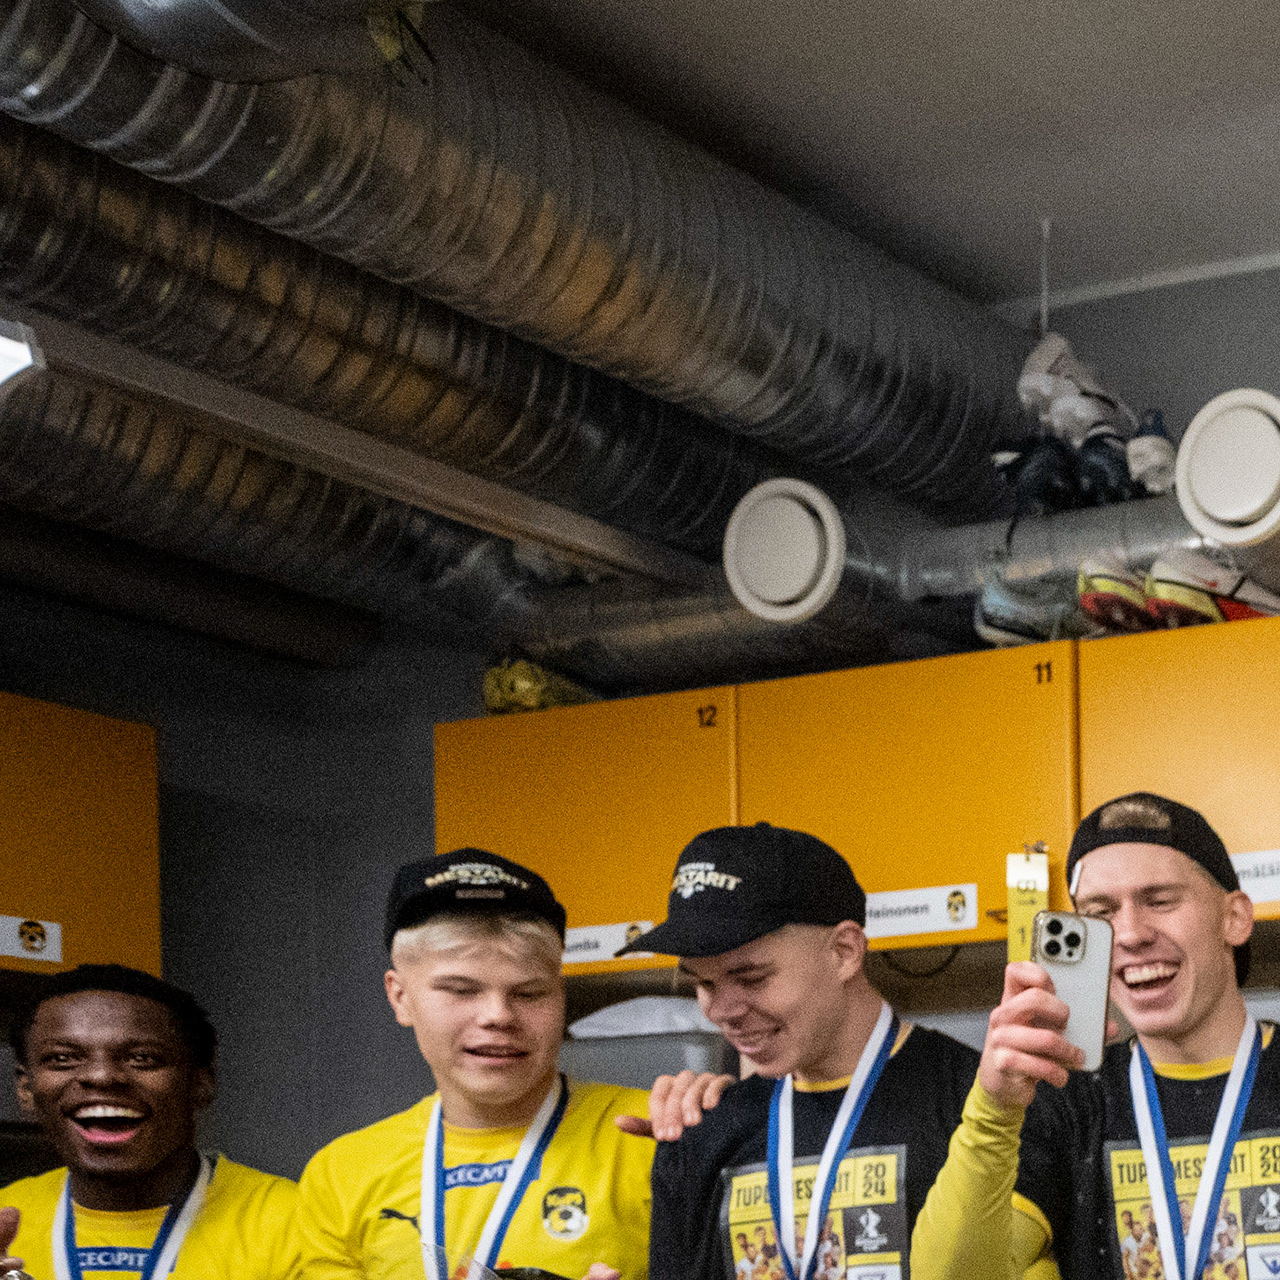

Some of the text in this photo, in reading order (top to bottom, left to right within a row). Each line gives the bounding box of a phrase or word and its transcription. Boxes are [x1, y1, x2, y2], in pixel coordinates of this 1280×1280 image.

[1033, 660, 1053, 685] 11
[696, 704, 718, 729] 12
[864, 1164, 887, 1179] 20
[863, 1179, 886, 1198] 24
